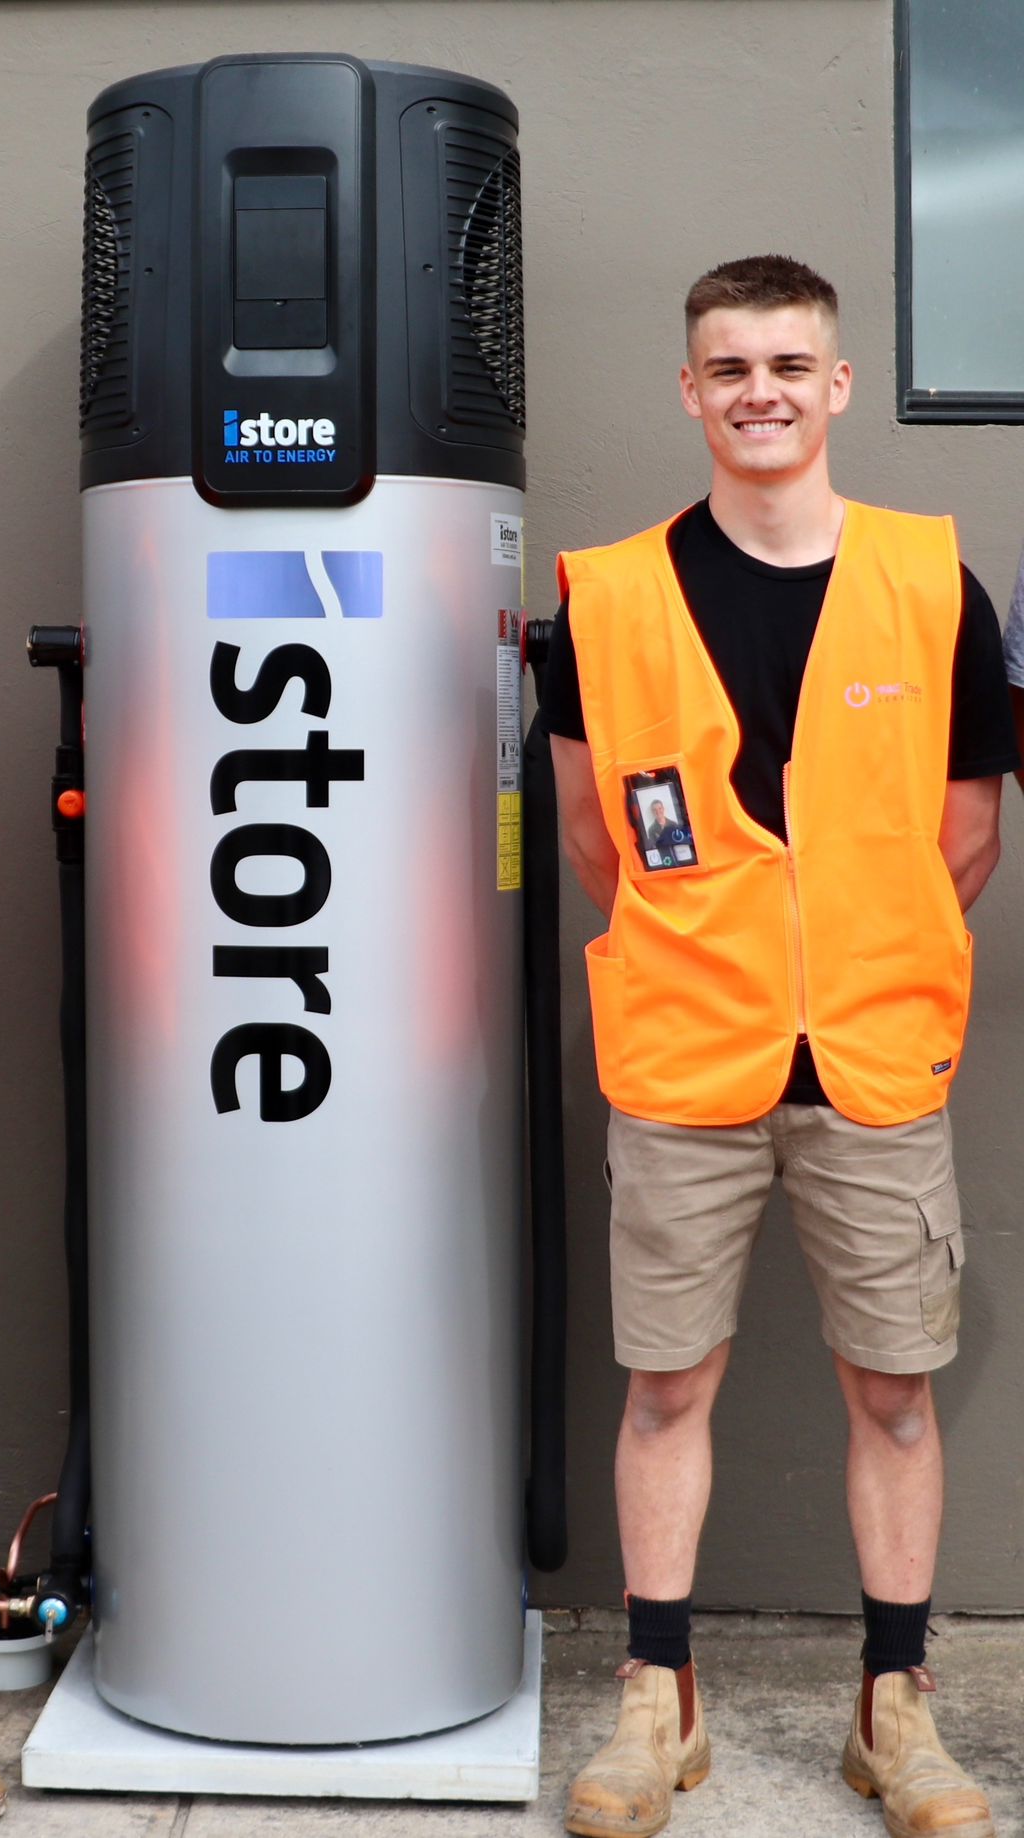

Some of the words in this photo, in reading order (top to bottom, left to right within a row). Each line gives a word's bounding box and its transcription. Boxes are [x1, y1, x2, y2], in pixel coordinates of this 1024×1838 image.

[223, 409, 336, 447] istore
[225, 450, 249, 463] AIR
[254, 450, 272, 463] TO
[278, 448, 336, 463] ENERGY
[206, 550, 383, 1122] istore
